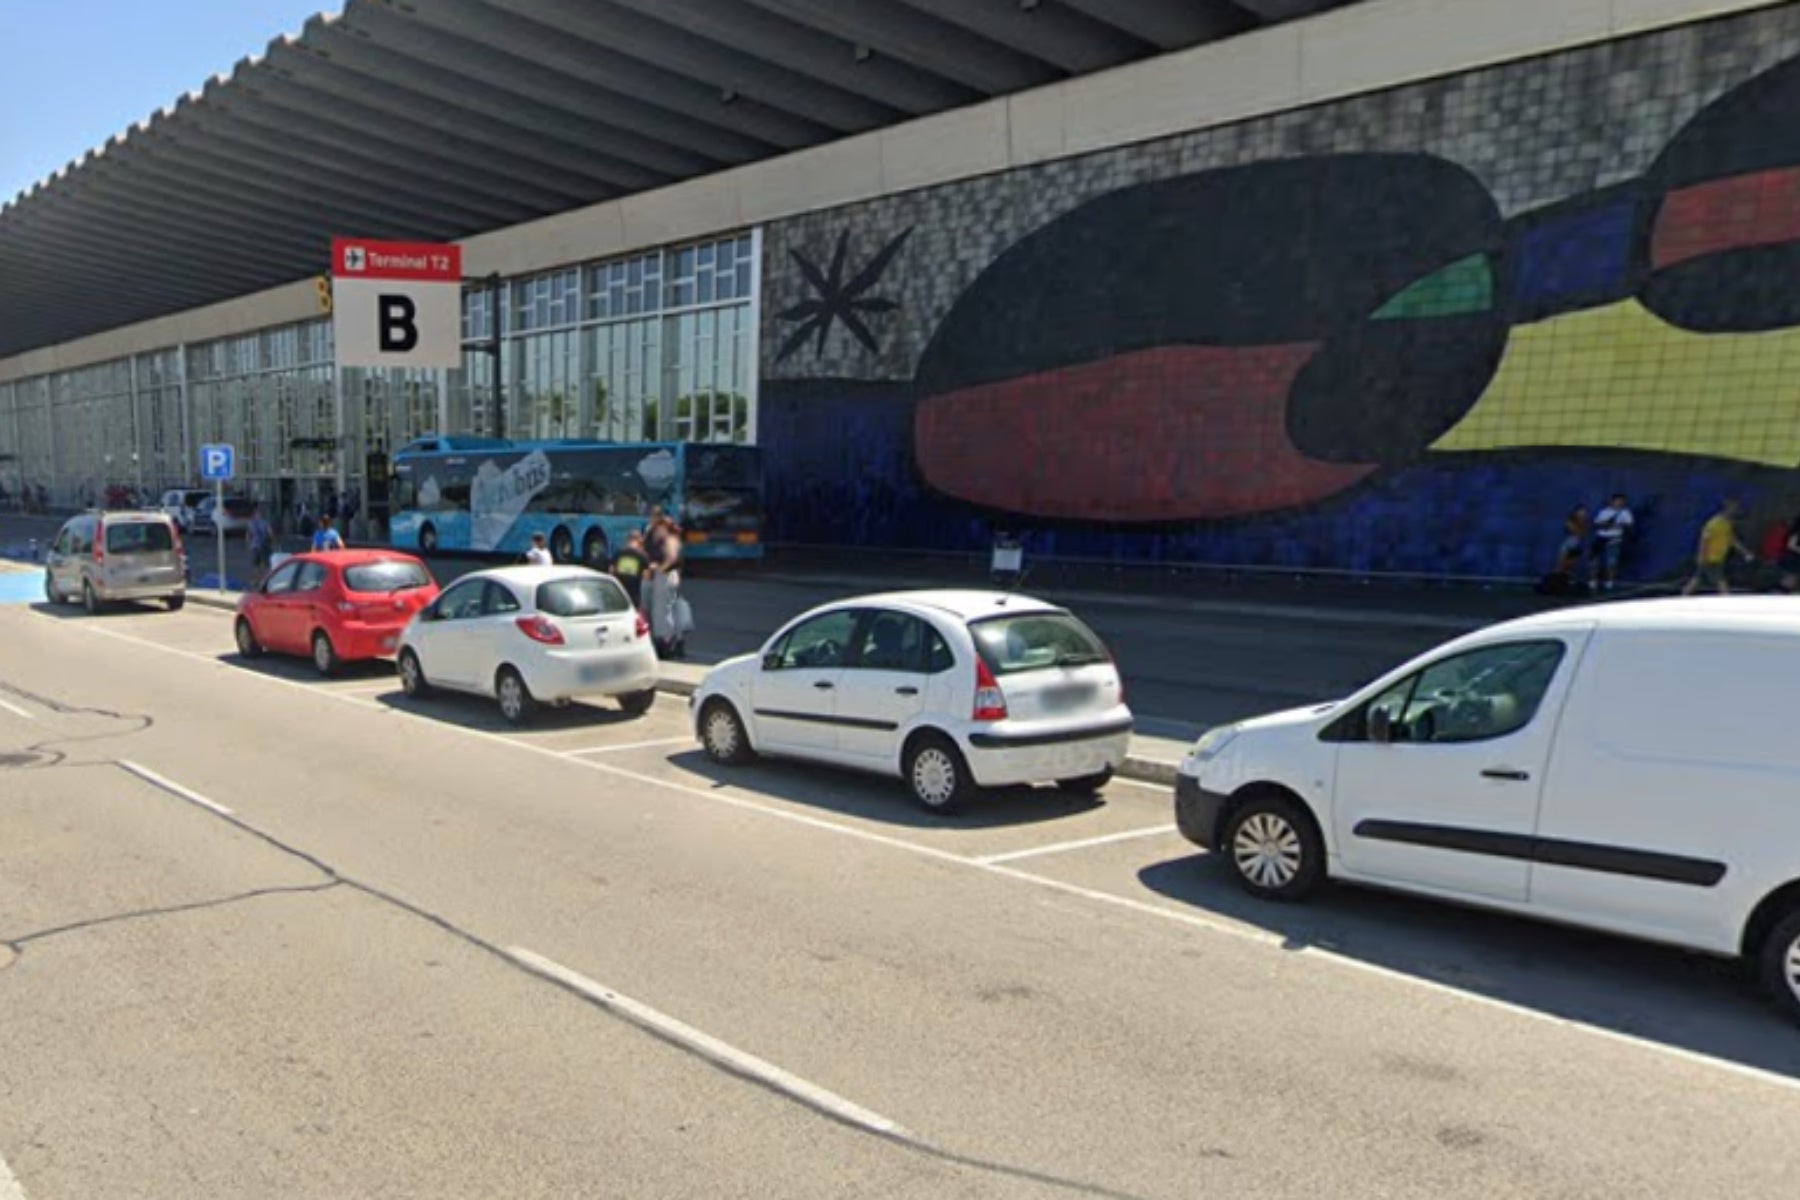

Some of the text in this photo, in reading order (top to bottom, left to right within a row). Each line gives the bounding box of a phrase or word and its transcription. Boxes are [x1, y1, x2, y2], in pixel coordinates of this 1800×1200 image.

[367, 252, 449, 271] Terminal T2
[378, 294, 419, 353] B
[208, 451, 226, 475] P
